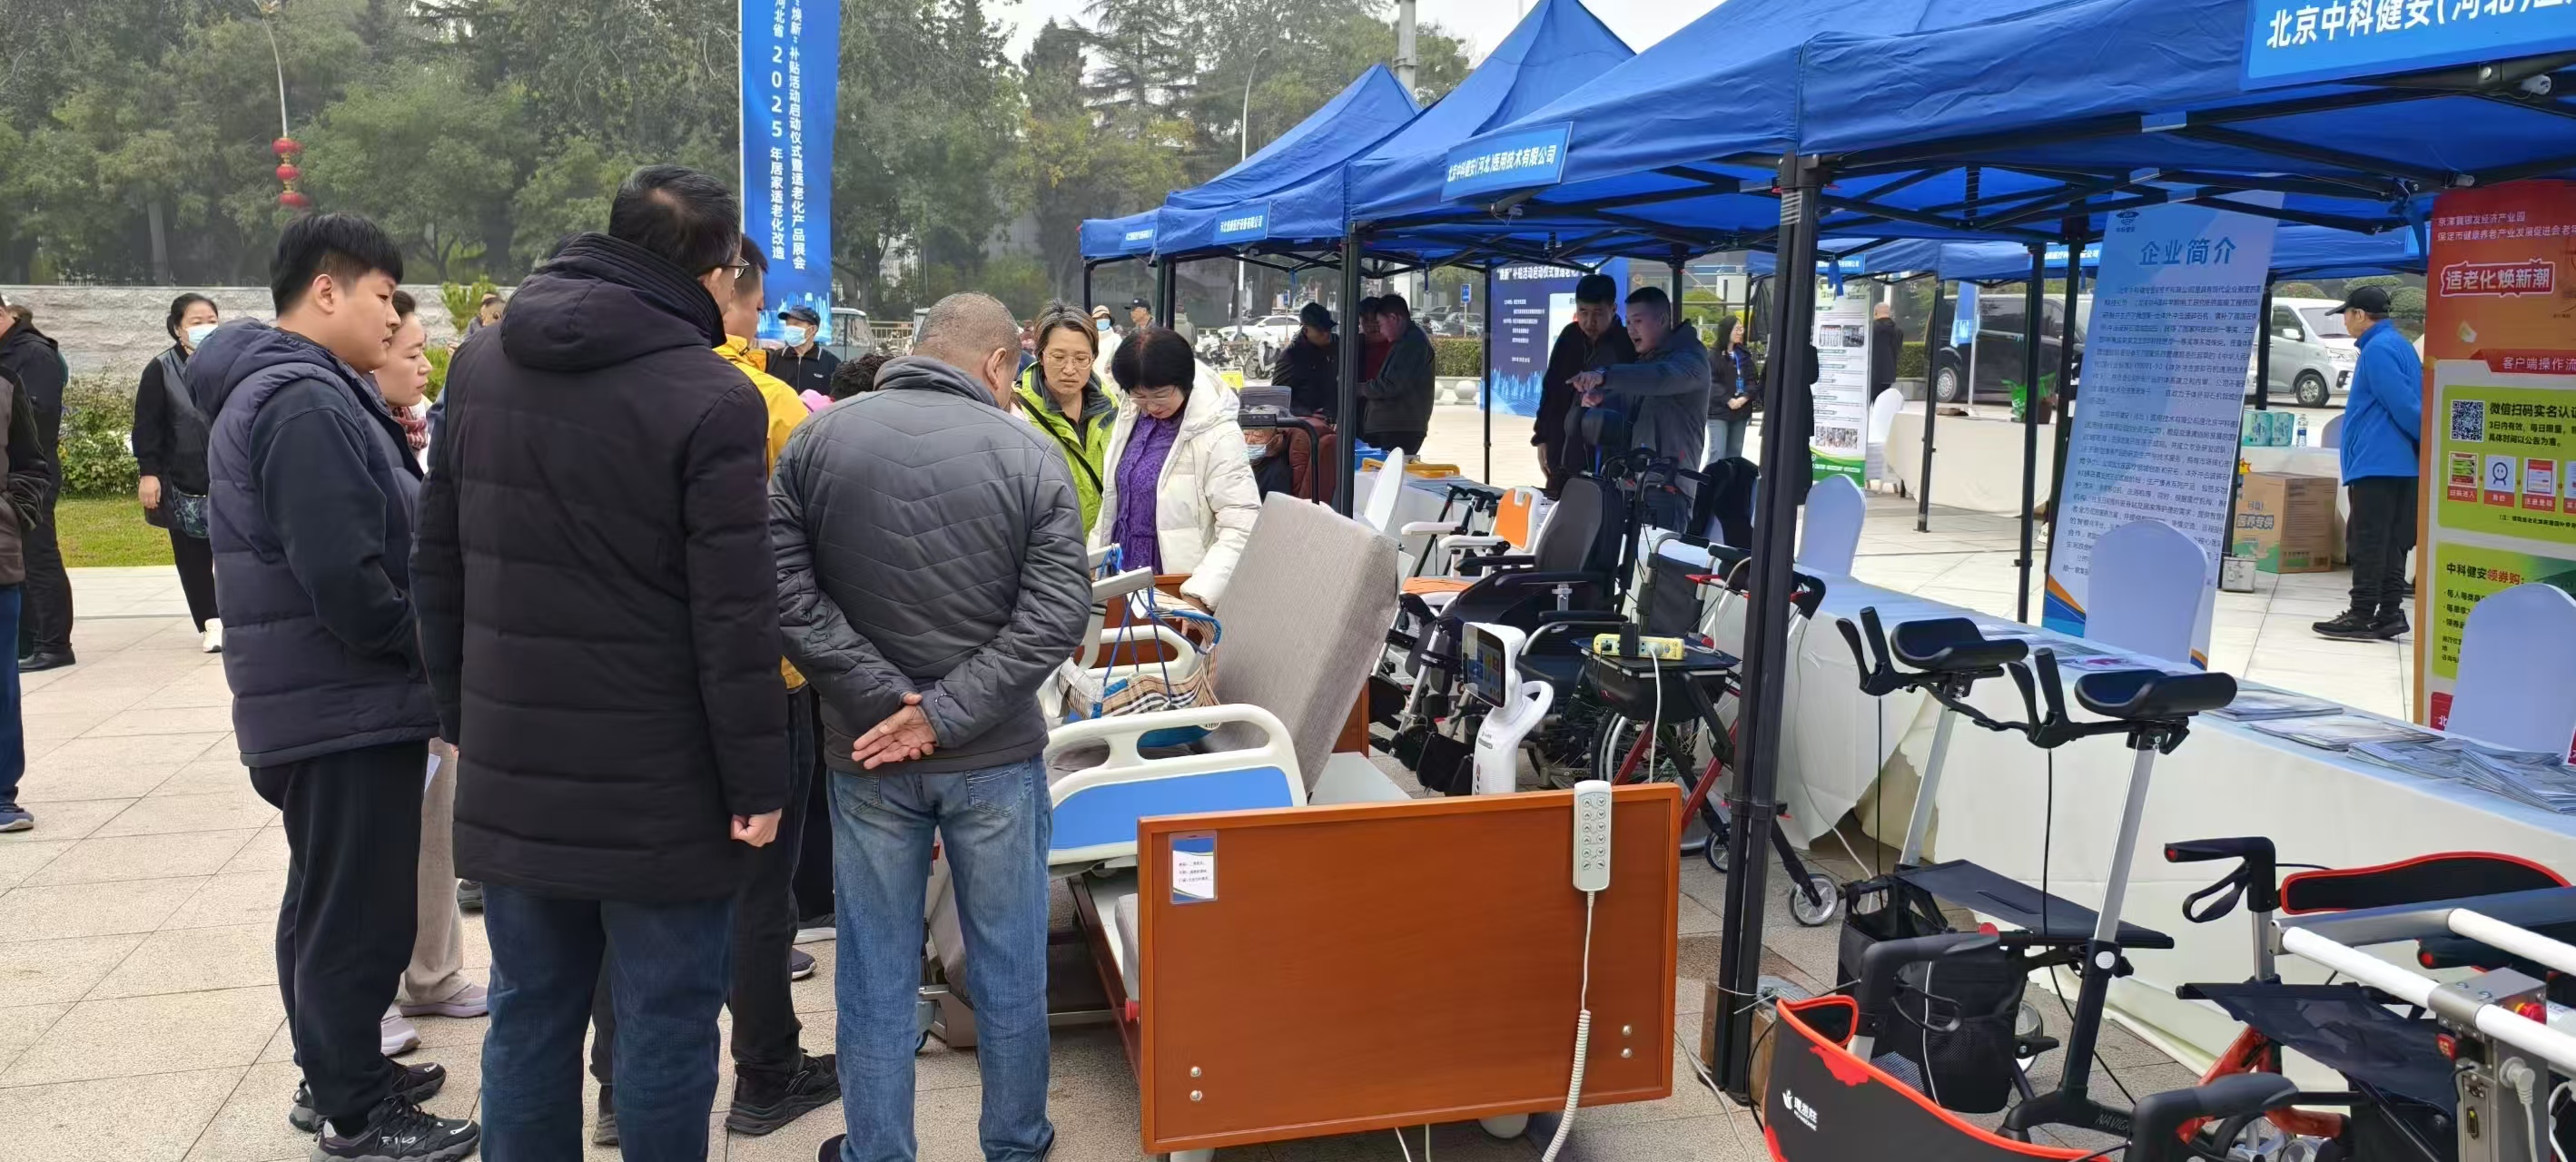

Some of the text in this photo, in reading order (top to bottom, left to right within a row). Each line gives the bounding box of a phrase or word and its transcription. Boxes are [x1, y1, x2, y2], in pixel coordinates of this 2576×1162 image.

[2139, 236, 2236, 266] 企业简介
[2446, 268, 2550, 290] 适老化焕新潮
